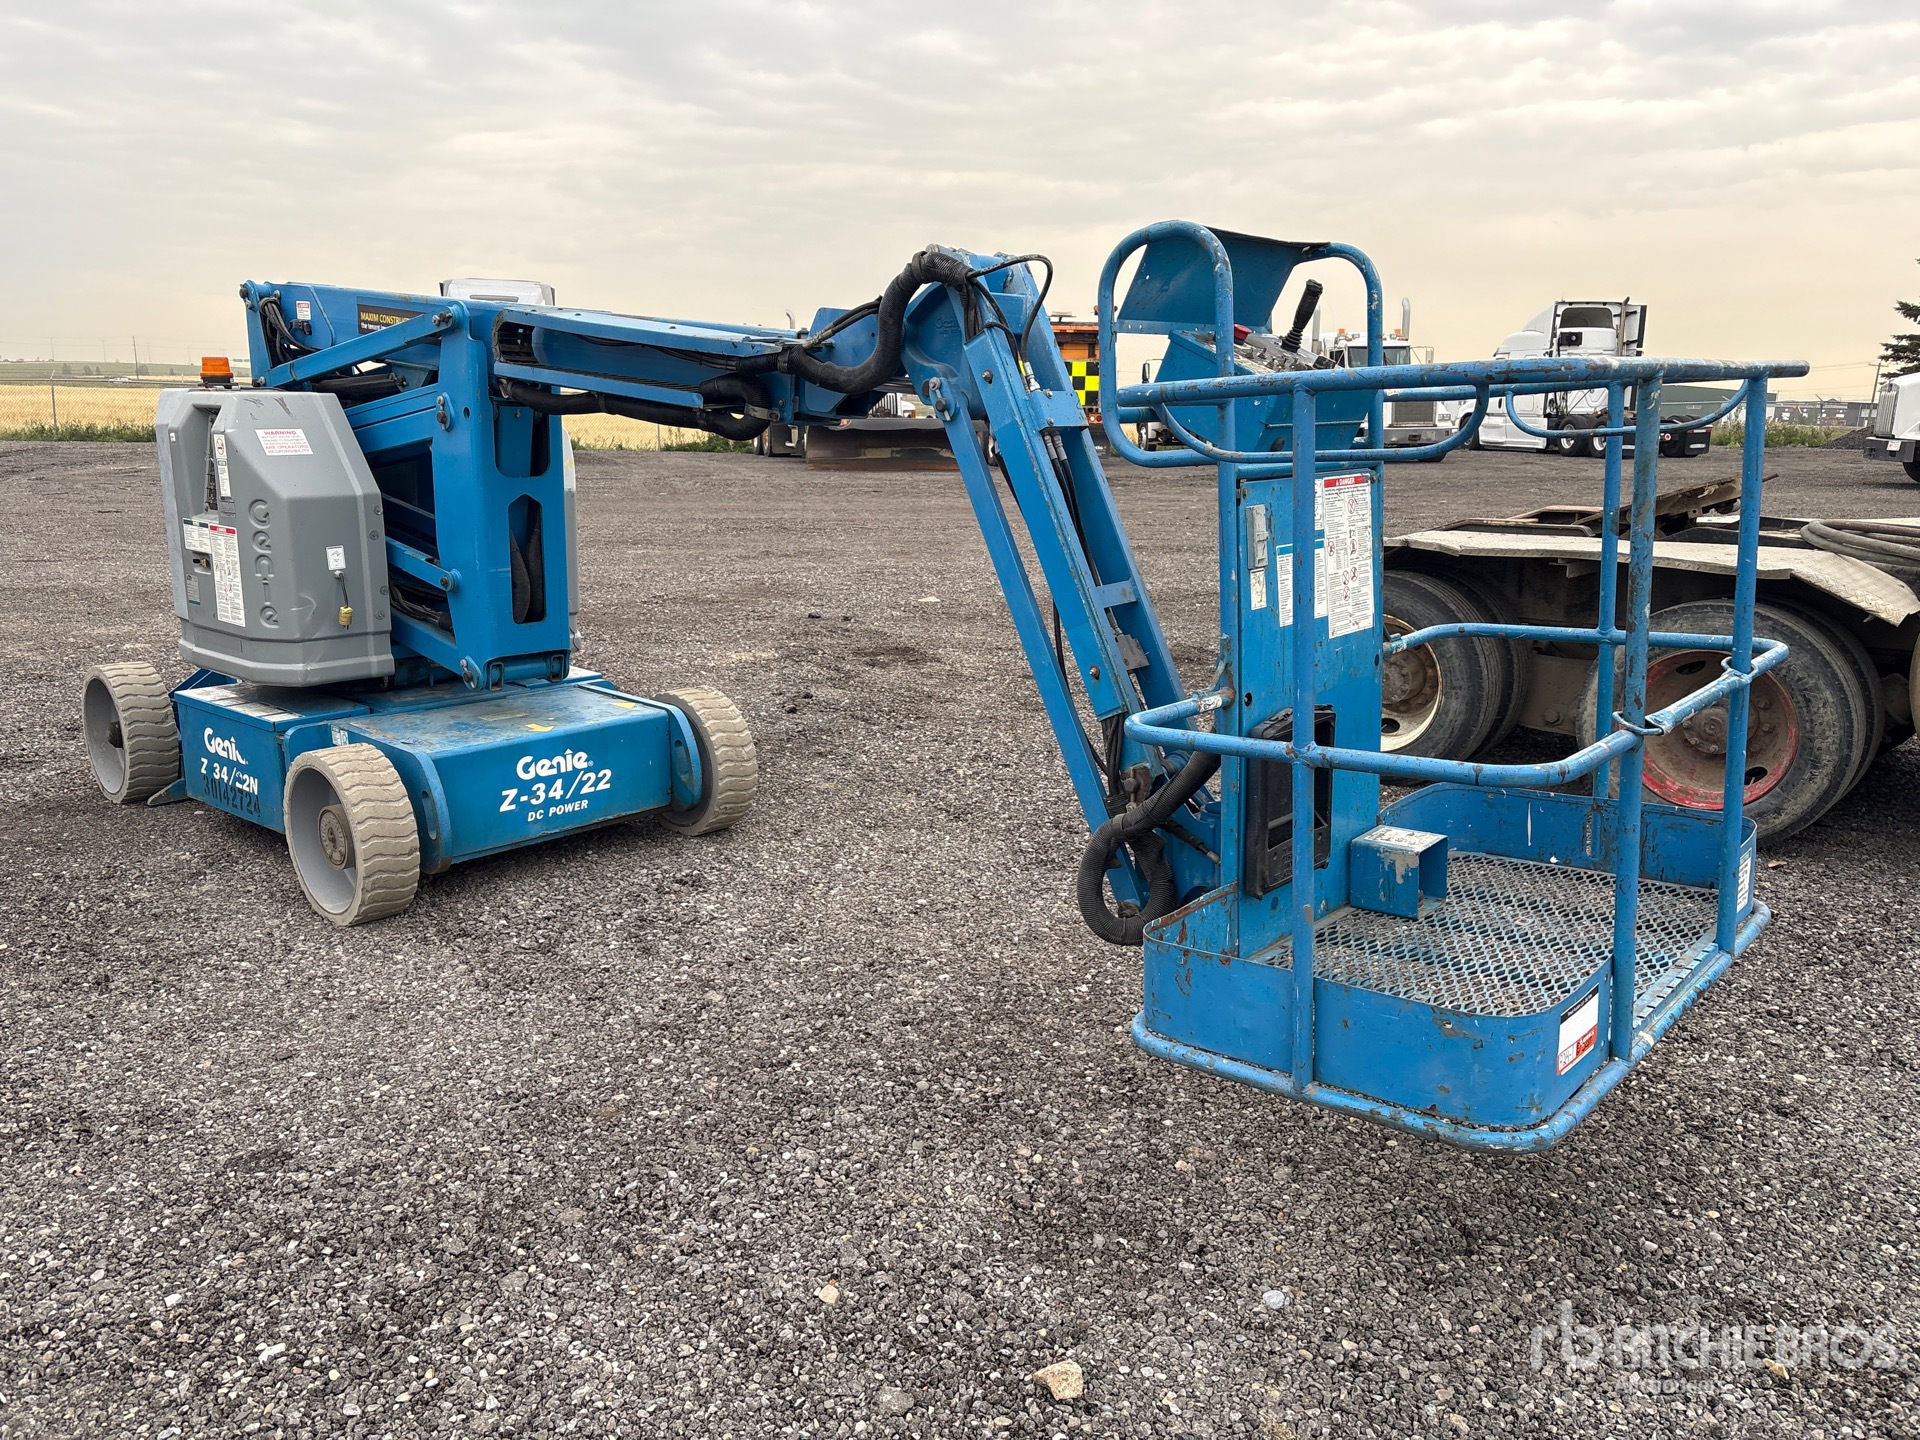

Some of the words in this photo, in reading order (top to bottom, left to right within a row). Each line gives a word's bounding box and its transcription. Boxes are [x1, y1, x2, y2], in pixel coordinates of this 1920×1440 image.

[360, 311, 379, 322] MAXIM
[1340, 477, 1355, 486] DANGER
[248, 498, 280, 629] Genie
[200, 757, 208, 774] Z
[516, 748, 588, 780] Genie
[499, 768, 612, 813] Z-34/22
[527, 809, 545, 822] DC
[548, 799, 589, 817] POWER
